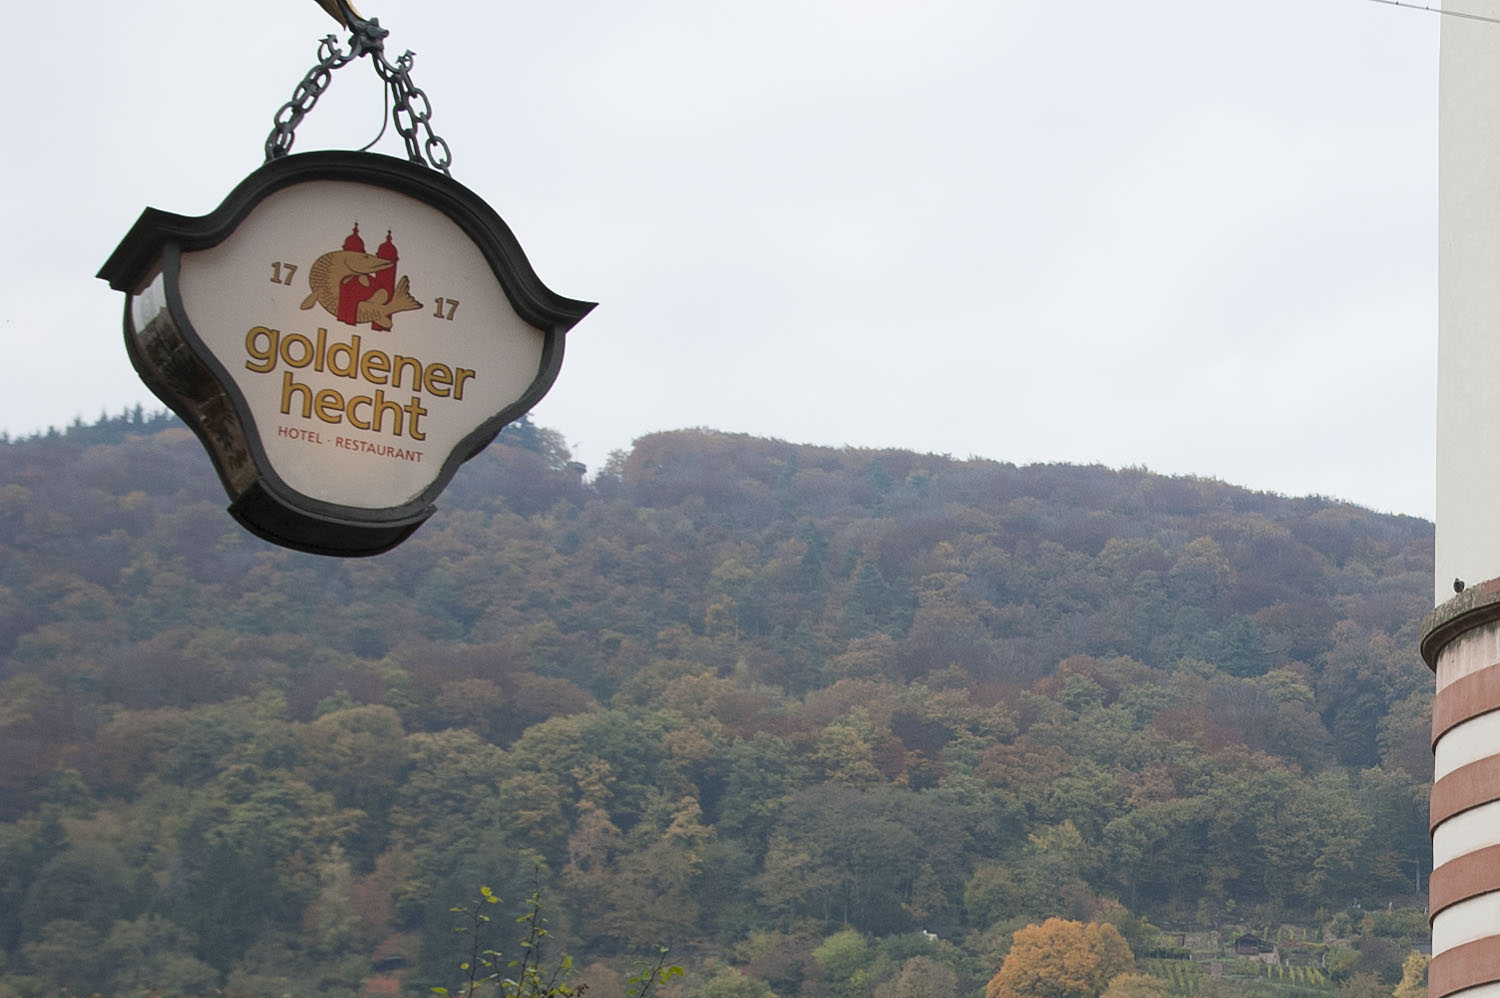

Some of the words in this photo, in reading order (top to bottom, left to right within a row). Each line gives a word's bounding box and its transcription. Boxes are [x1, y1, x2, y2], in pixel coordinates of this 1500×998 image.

[269, 261, 298, 287] 17
[432, 296, 460, 321] 17
[245, 325, 476, 401] goldener
[280, 371, 428, 441] hecht
[278, 425, 322, 445] HOTEL
[335, 437, 424, 463] RESTAURANT
